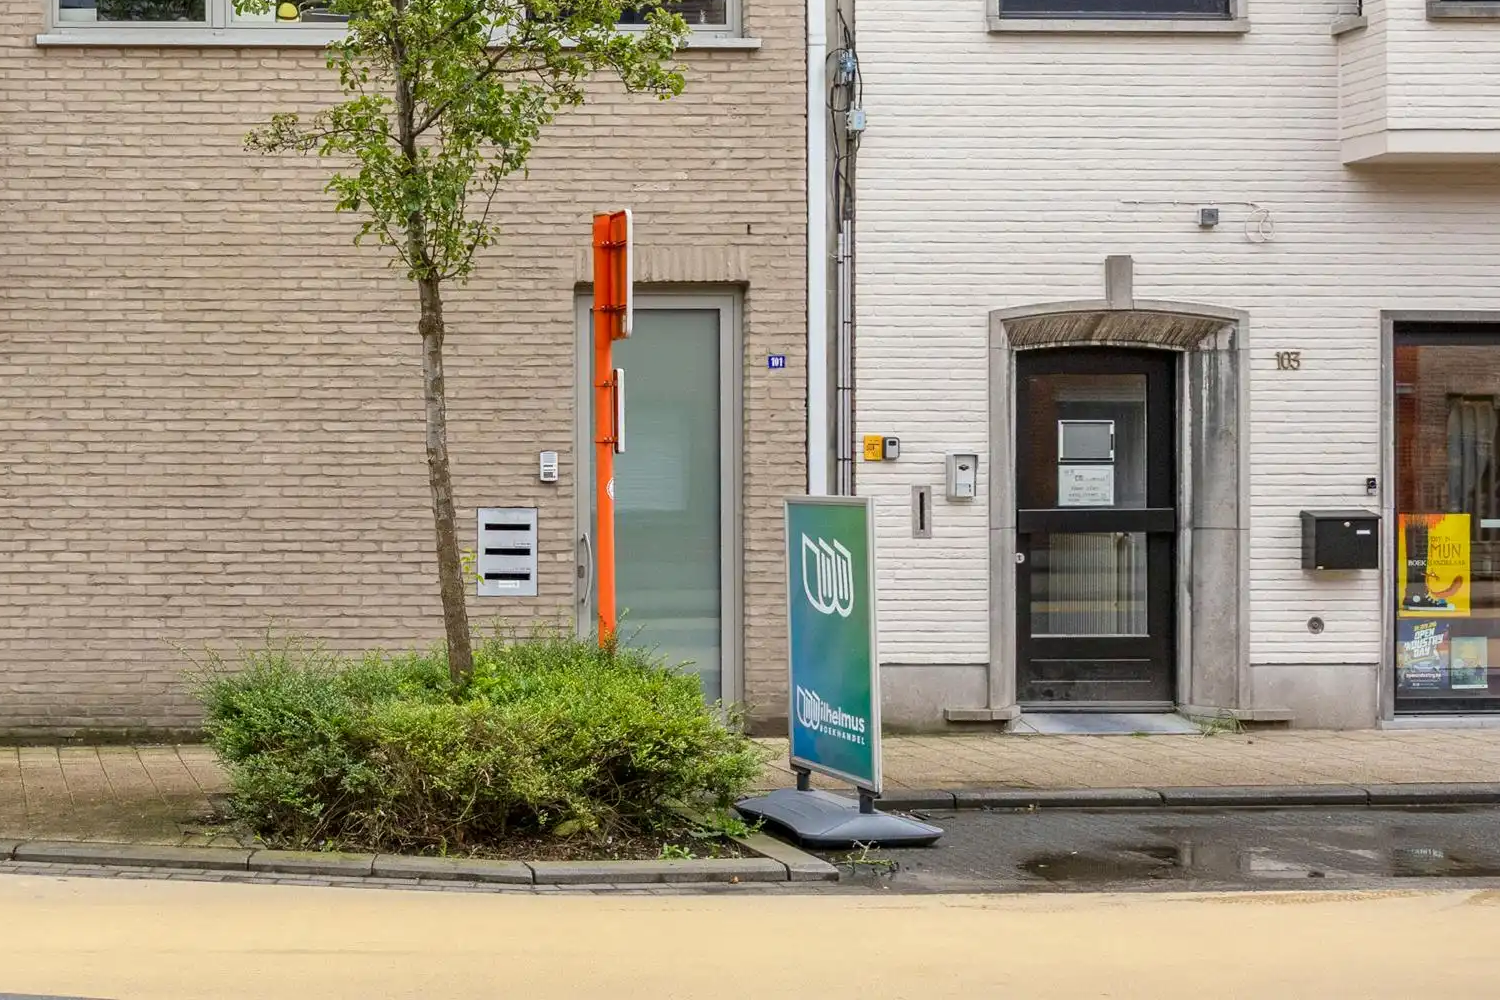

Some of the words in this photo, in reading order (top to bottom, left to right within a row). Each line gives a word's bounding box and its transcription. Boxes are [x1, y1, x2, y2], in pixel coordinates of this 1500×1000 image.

[770, 357, 783, 367] 101
[1274, 351, 1301, 370] 103
[796, 685, 866, 733] Wilhelmus
